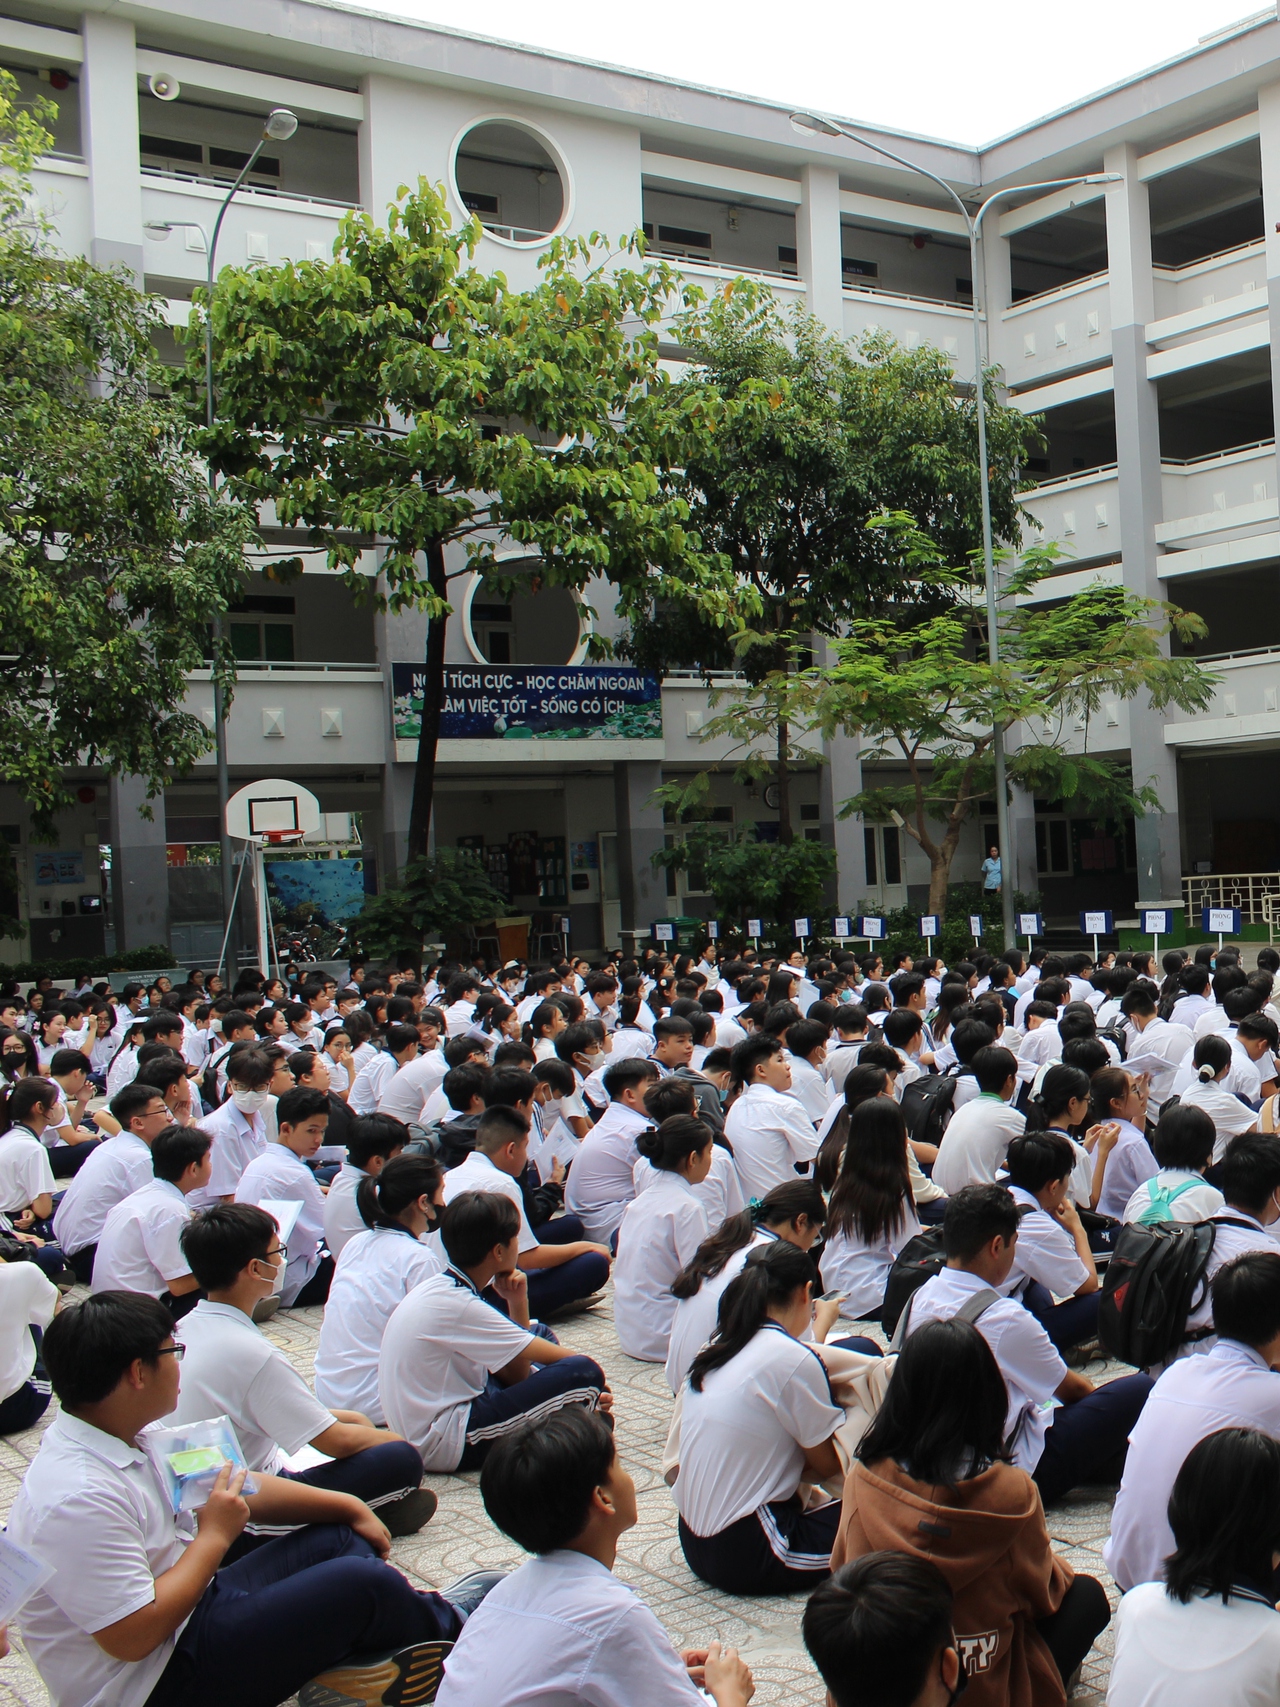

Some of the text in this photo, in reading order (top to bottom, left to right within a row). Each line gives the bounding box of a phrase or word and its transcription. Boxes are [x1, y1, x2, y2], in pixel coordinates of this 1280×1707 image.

[450, 671, 483, 689] TÍCH
[484, 674, 513, 694] CỰC
[526, 675, 556, 694] HỌC
[558, 673, 596, 690] CHĂM
[600, 676, 645, 691] NGOAN
[467, 695, 499, 717] VIỆC
[501, 694, 528, 714] TỐT
[540, 694, 577, 715] SỐNG
[581, 695, 601, 715] CÓ
[603, 695, 625, 715] ÍCH
[1087, 914, 1104, 922] PHÒNG
[1212, 911, 1231, 920] PHÒNG
